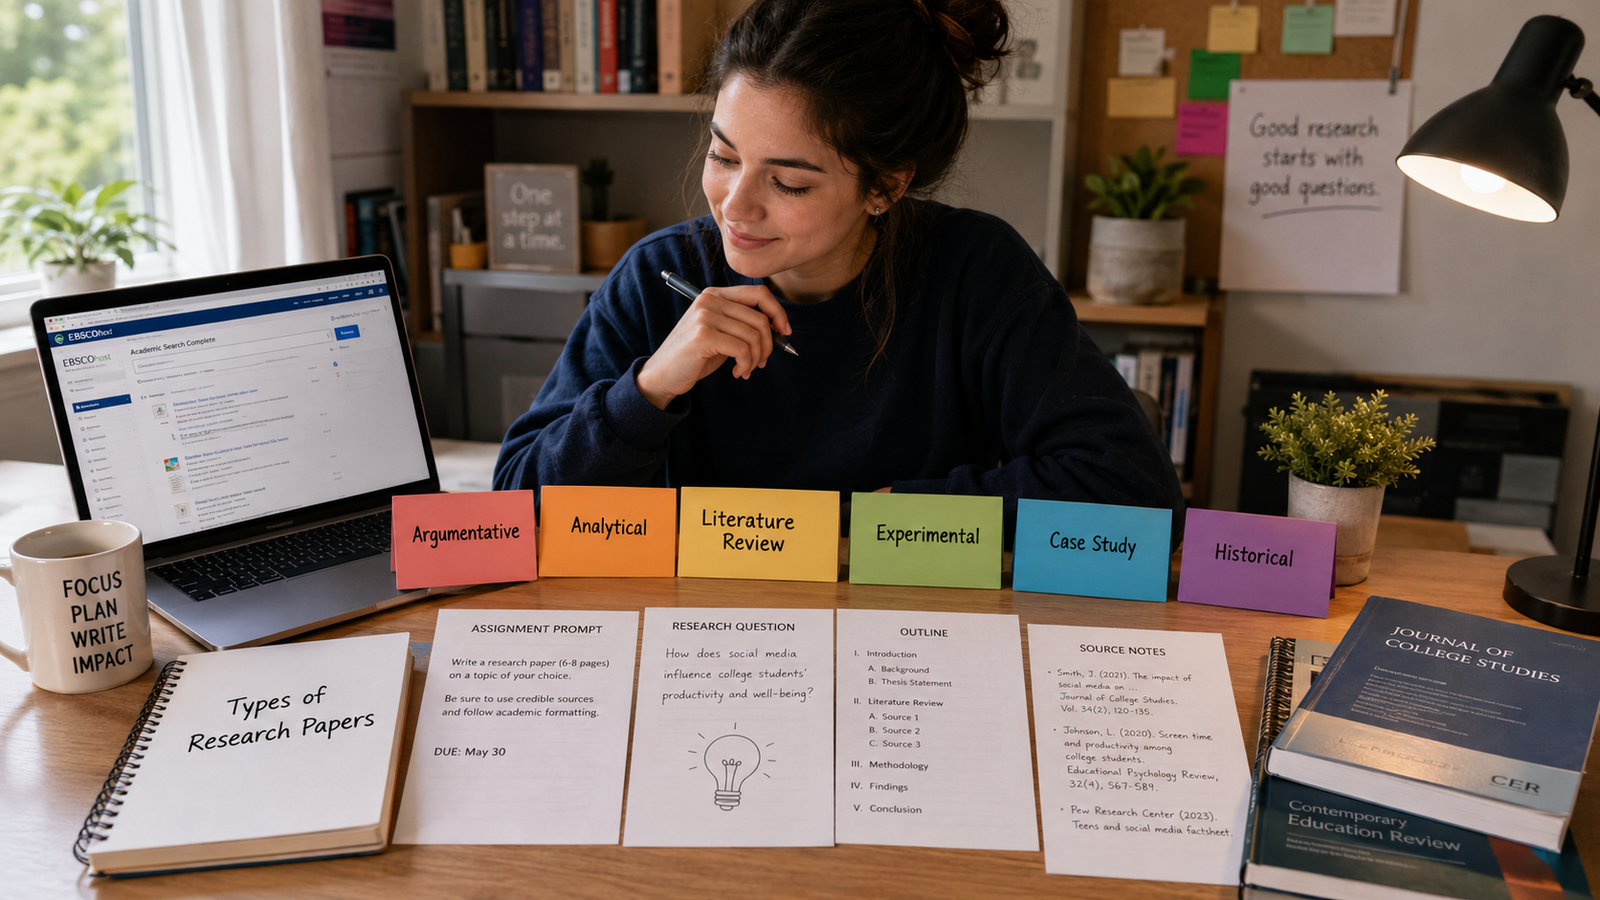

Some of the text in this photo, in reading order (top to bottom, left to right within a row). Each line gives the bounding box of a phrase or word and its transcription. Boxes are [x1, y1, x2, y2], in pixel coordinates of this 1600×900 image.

[1250, 112, 1300, 138] Good
[1308, 114, 1379, 138] research
[1262, 145, 1364, 167] starts with
[510, 182, 552, 205] One
[1248, 174, 1380, 206] good questions.
[501, 208, 562, 233] step at
[502, 231, 565, 251] a time.
[130, 337, 216, 355] Academic Search Complete
[570, 516, 647, 540] Analytical
[702, 509, 795, 530] Literature
[412, 524, 520, 549] Argumentative
[723, 532, 785, 553] Review
[876, 524, 980, 547] Experimental
[1050, 531, 1137, 560] Case Study
[1214, 542, 1294, 568] Historical
[62, 570, 123, 598] FOCUS
[71, 598, 118, 624] PLAN
[71, 622, 127, 649] WRITE
[471, 625, 603, 634] ASSIGNMENT PROMPT
[672, 622, 795, 631] RESEARCH QUESTION
[900, 628, 948, 637] OUTLINE
[1080, 644, 1166, 656] SOURCE NOTES
[1390, 627, 1514, 658] JOURNAL OF
[72, 644, 134, 674] IMPACT
[665, 648, 797, 658] How does social media
[1386, 639, 1560, 683] COLLEGE STUDIES
[530, 660, 556, 669] paper
[559, 659, 577, 668] (6-8
[580, 659, 610, 669] pages)
[881, 666, 930, 674] Background
[474, 672, 498, 680] topic
[513, 672, 535, 681] your
[664, 669, 712, 679] influence
[718, 669, 752, 682] college
[1057, 669, 1084, 678] Smith,
[1099, 671, 1130, 680] (2021).
[1152, 674, 1179, 683] impact
[227, 685, 327, 721] Types of
[662, 687, 814, 705] productivity and well-being?
[1060, 692, 1092, 701] Journal
[1109, 694, 1139, 705] College
[1143, 696, 1177, 705] Studies.
[546, 708, 599, 718] formatting.
[1114, 707, 1153, 716] 120-135.
[188, 712, 375, 753] Research Papers
[1063, 726, 1103, 737] Johnson,
[1120, 729, 1155, 738] (2020).
[1159, 731, 1188, 740] Screen
[434, 748, 506, 758] DUE: May 30
[1085, 742, 1139, 753] productivity
[1144, 745, 1172, 754] among
[870, 761, 928, 771] Methodology
[1066, 753, 1145, 764] college students.
[1067, 766, 1219, 782] Educational Psychology Review,
[870, 783, 908, 792] Findings
[1070, 780, 1158, 792] 32(4), 567-589.
[1491, 775, 1540, 793] CER
[870, 805, 922, 814] Conclusion
[1071, 805, 1217, 822] Pew Research Center (2023).
[1289, 800, 1407, 829] Contemporary
[1072, 820, 1099, 830] Teens
[1125, 824, 1150, 833] social
[1155, 826, 1183, 834] media
[1187, 826, 1233, 837] factsheet.
[1288, 814, 1461, 851] Education Review
